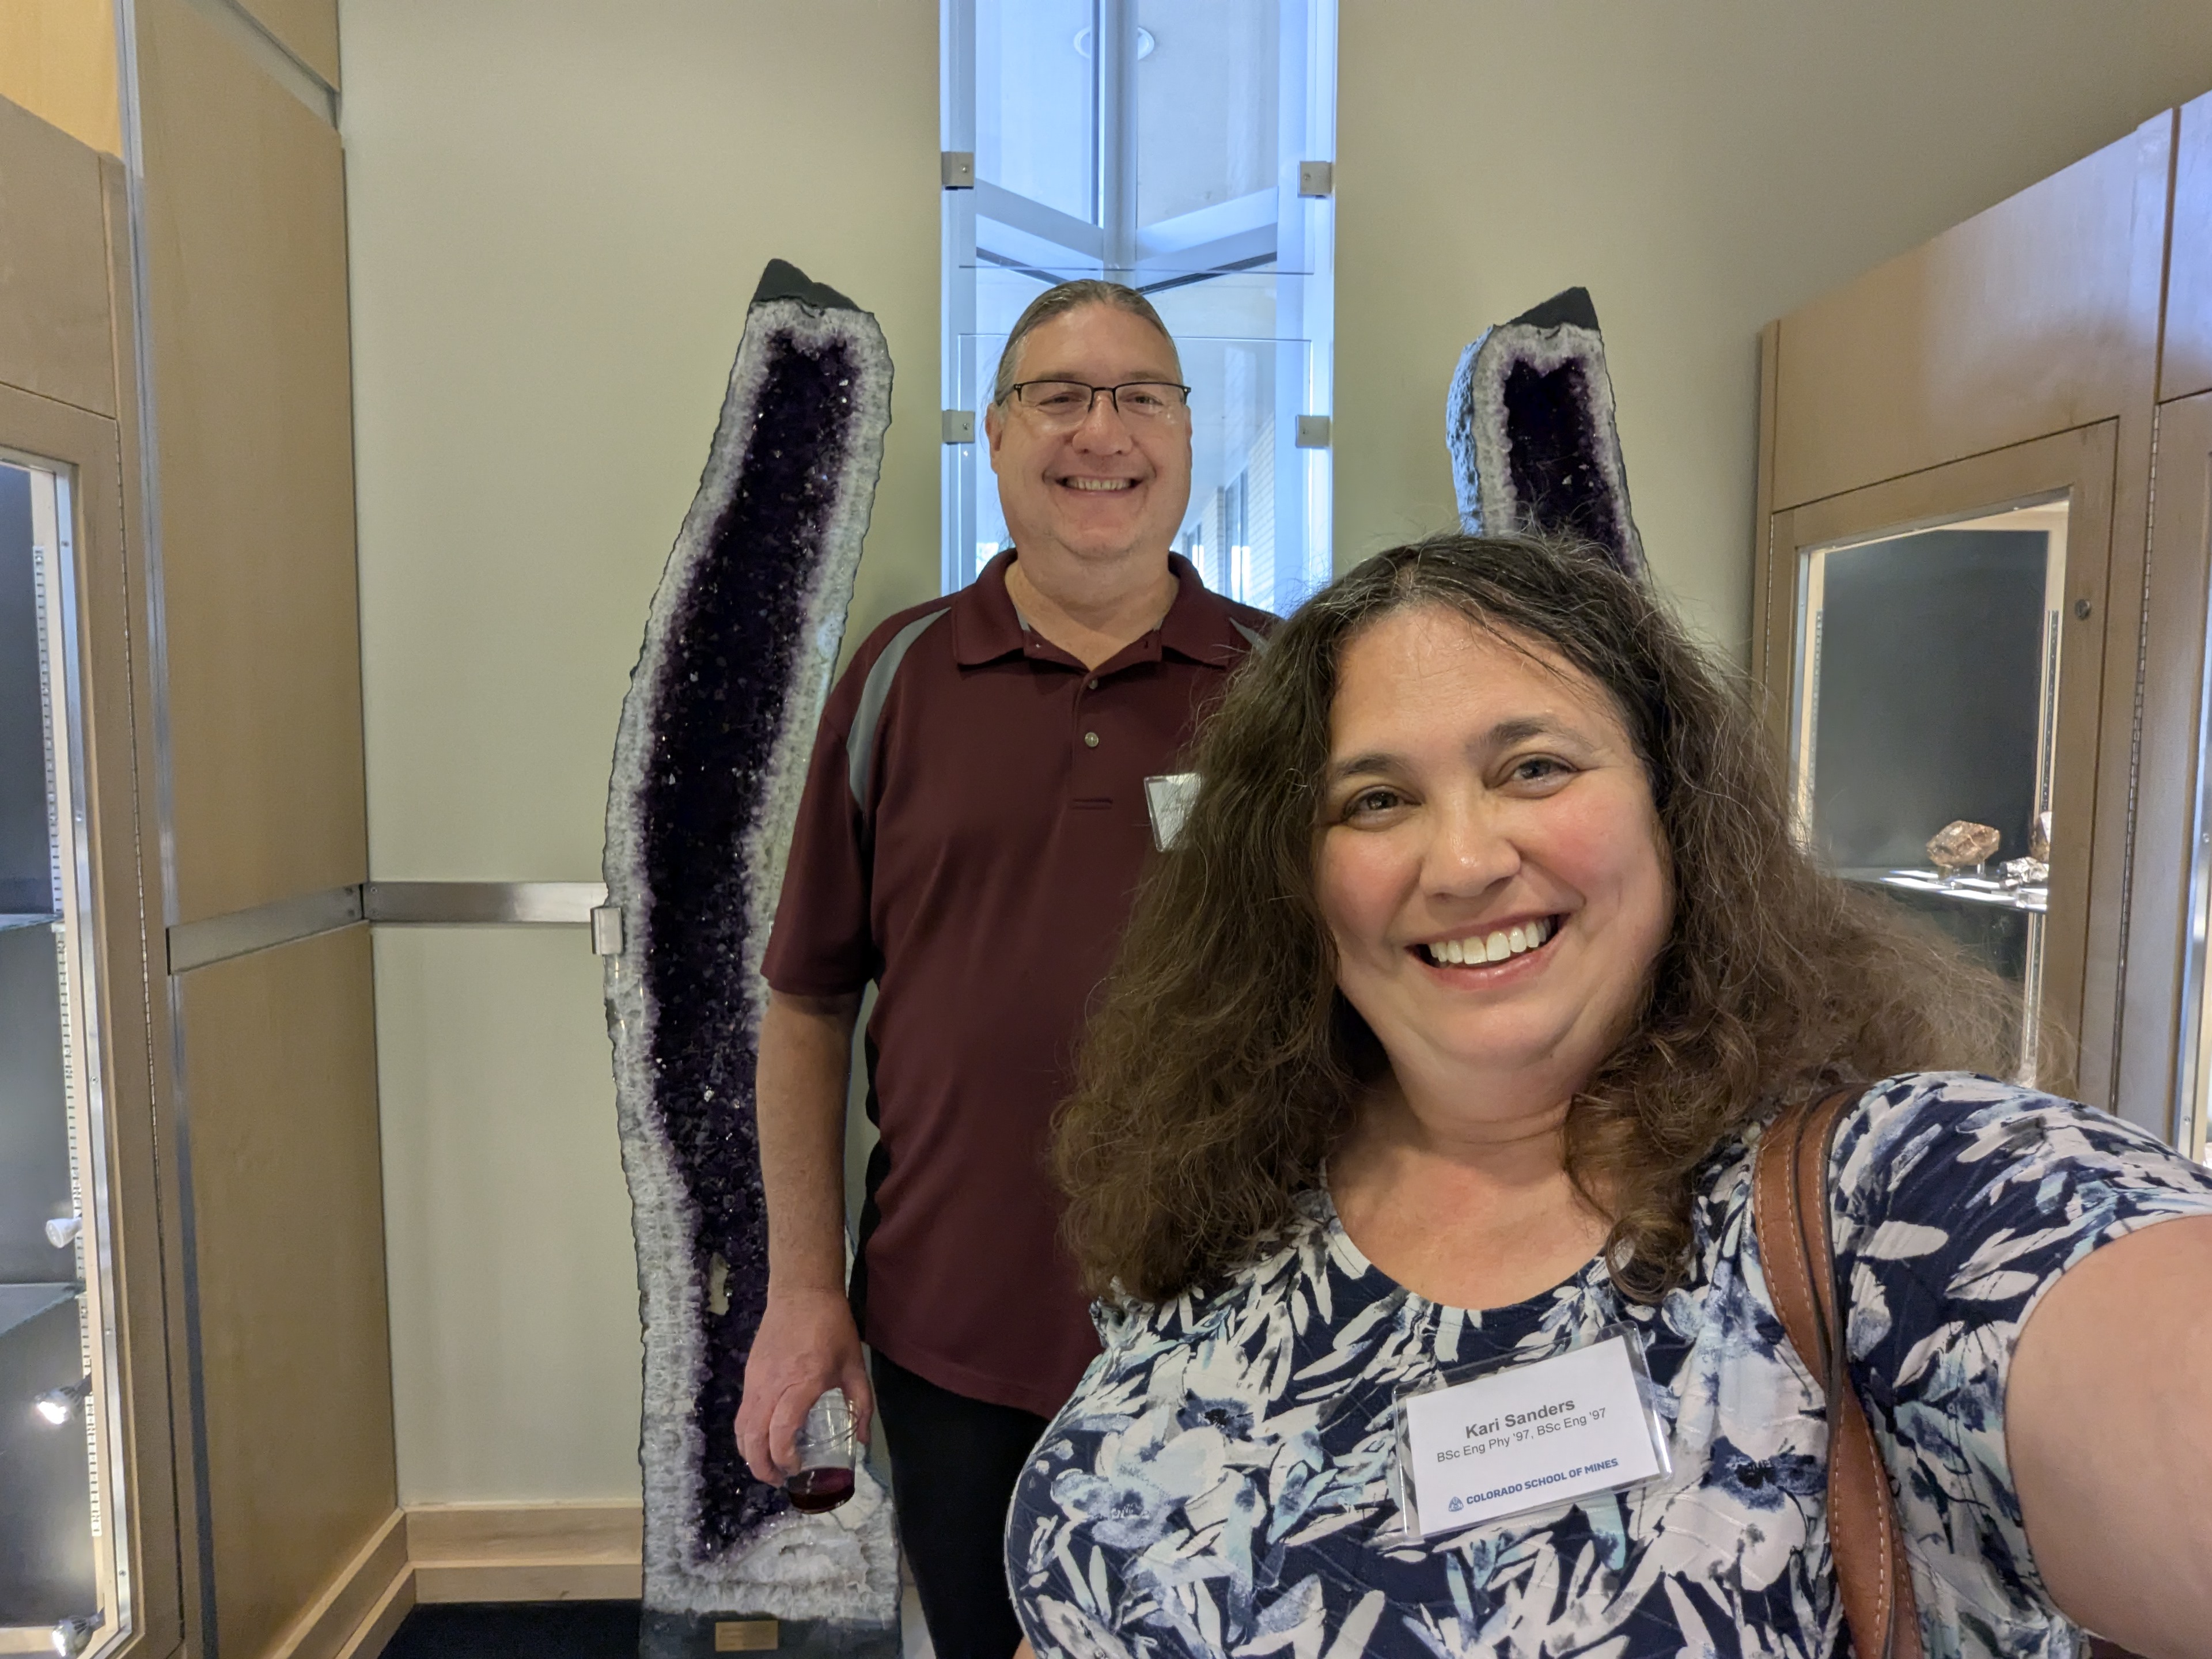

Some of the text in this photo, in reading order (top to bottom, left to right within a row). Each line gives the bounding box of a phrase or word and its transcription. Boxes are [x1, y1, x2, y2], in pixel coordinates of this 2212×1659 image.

[1437, 1407, 1606, 1462] BSc Eng Phy '97, BSc Eng '97
[1465, 1400, 1575, 1438] Kari Sanders
[1466, 1458, 1619, 1504] COLORADO SCHOOL OF MINES
